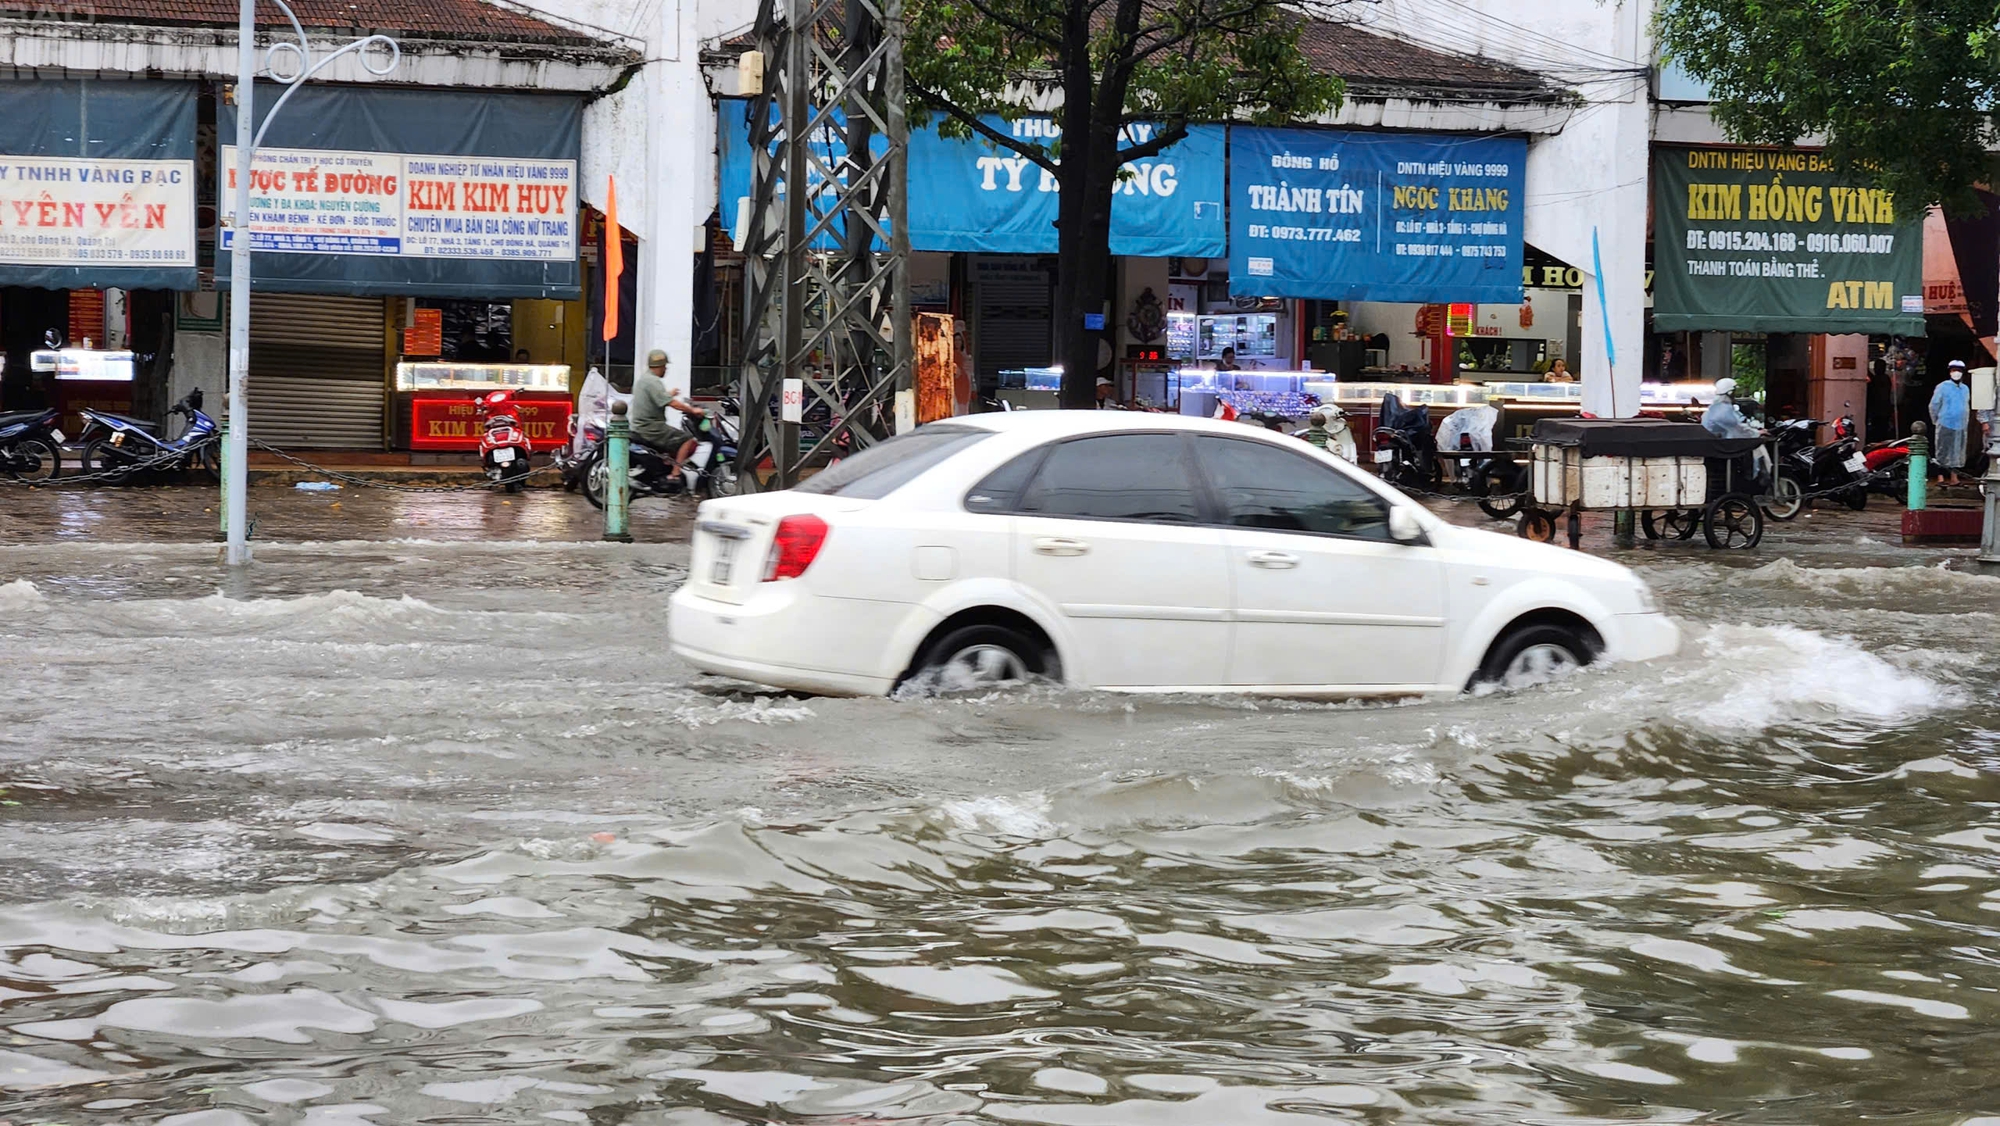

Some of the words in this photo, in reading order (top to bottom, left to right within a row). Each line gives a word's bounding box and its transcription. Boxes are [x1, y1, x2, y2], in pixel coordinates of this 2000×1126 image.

[1011, 118, 1062, 137] THU
[1271, 151, 1313, 169] ĐỒNG
[1319, 153, 1339, 171] HỒ
[1397, 162, 1426, 175] DNTN
[1428, 160, 1452, 178] HIỆU
[1454, 161, 1483, 176] VÀNG
[1484, 164, 1508, 177] 9999
[1688, 151, 1727, 169] DNTN
[16, 166, 71, 181] TNHH
[78, 165, 134, 183] VÀNG
[141, 169, 181, 187] BẠC
[292, 165, 319, 192] TẾ
[325, 169, 397, 195] ĐƯỜNG
[409, 162, 436, 175] DOANH
[438, 161, 467, 178] NGHIỆP
[470, 163, 480, 176] TƯ
[482, 162, 504, 177] NHÂN
[506, 163, 524, 181] HIỆU
[526, 163, 548, 179] VÀNG
[550, 167, 568, 179] 9999
[409, 180, 455, 211] KIM
[463, 182, 509, 212] KIM
[517, 184, 568, 214] HUY
[1248, 181, 1322, 213] THÀNH
[1326, 183, 1364, 214] TÍN
[1393, 186, 1439, 216] NGỌC
[1448, 187, 1509, 211] KHANG
[1688, 183, 1741, 220] KIM
[1749, 172, 1823, 222] HỒNG
[288, 213, 309, 225] BỆNH
[408, 214, 441, 232] CHUYÊN
[444, 218, 463, 233] MUA
[466, 215, 483, 234] BÁN
[486, 219, 499, 234] GIA
[502, 216, 525, 235] CÔNG
[528, 218, 540, 235] NỮ
[542, 221, 568, 236] TRANG
[1249, 224, 1269, 238] ĐT:
[1271, 225, 1361, 242] 0973.777.462
[1687, 230, 1707, 250] ĐT:
[1708, 231, 1796, 252] 0915.204.168
[1807, 233, 1894, 253] 0916.060.007
[1687, 260, 1726, 276] THANH
[1728, 258, 1761, 277] TOÁN
[1762, 256, 1794, 277] BẰNG
[1168, 293, 1185, 310] ÍN
[1826, 281, 1894, 310] ATM
[429, 420, 467, 437] KIM
